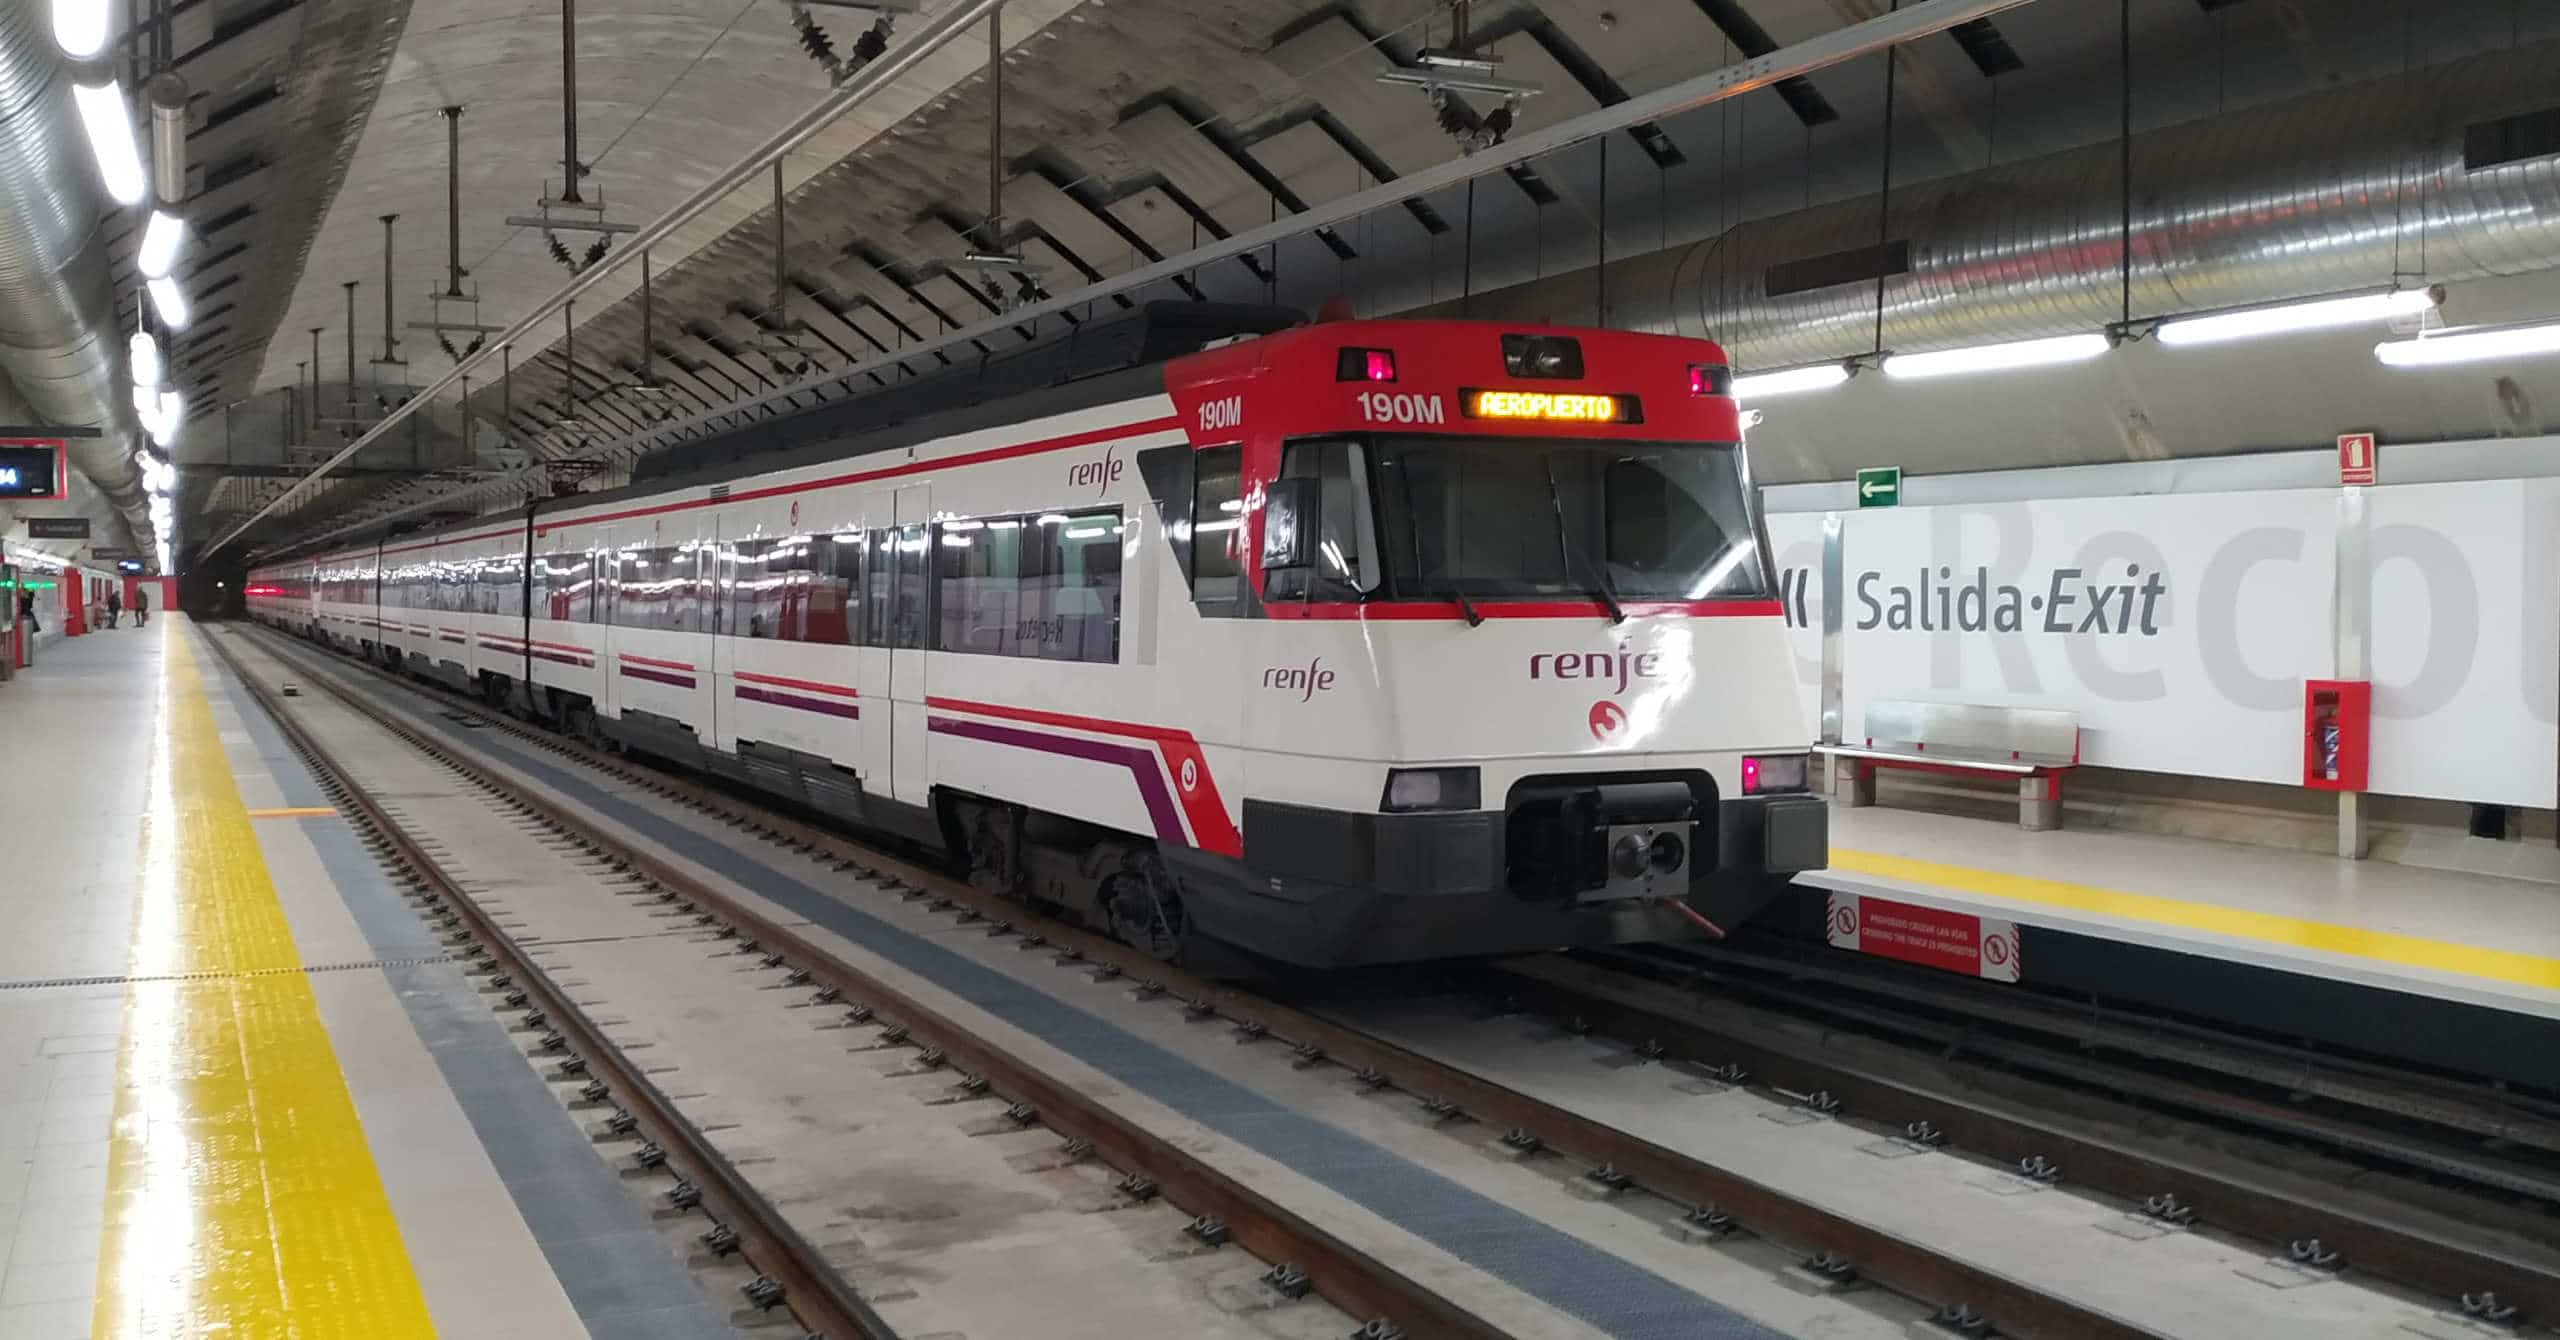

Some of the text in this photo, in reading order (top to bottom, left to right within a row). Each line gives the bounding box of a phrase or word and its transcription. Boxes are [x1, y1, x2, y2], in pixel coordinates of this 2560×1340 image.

[1198, 395, 1242, 431] 190M
[1357, 391, 1445, 426] 190M
[1480, 391, 1613, 420] AEROPUERTO
[1067, 445, 1124, 498] renfe
[1262, 656, 1336, 703] renfe
[1530, 636, 1660, 695] renfe
